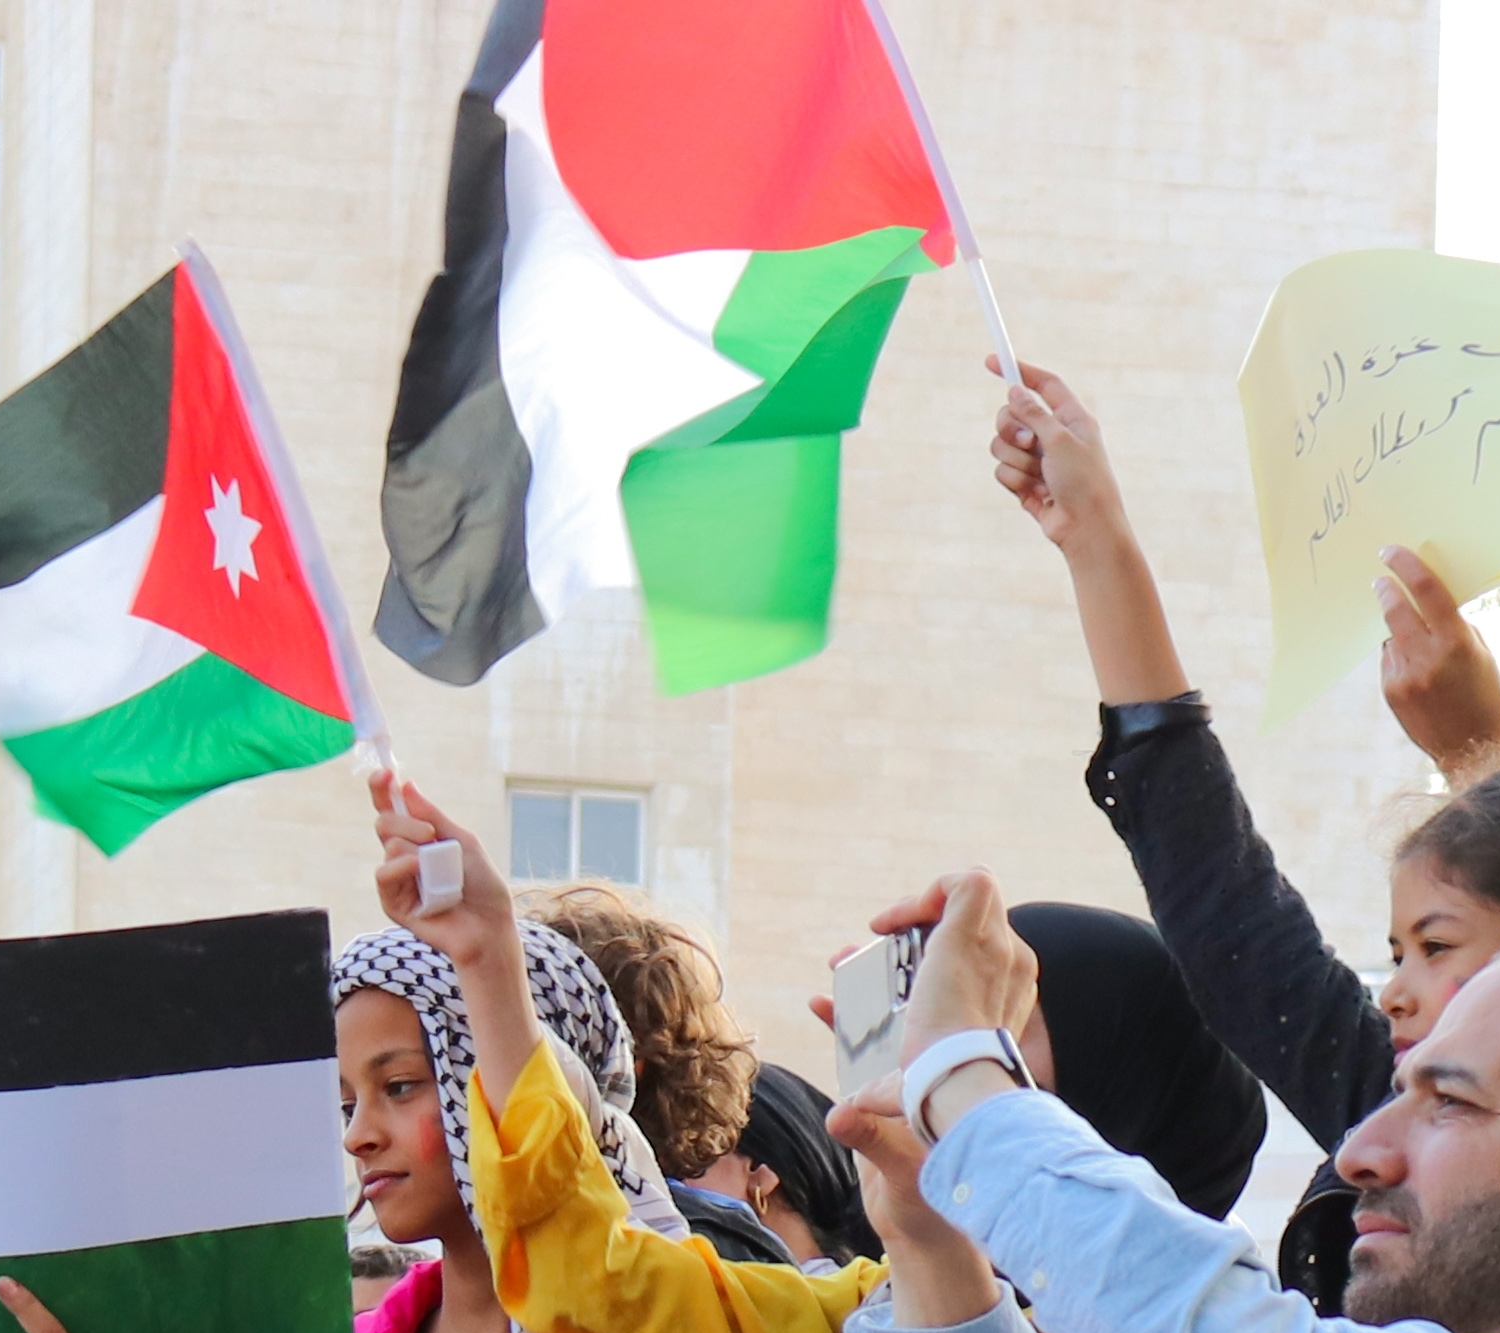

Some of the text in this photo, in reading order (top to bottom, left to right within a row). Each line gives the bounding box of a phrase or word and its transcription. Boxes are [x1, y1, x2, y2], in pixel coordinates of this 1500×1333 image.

[1293, 350, 1348, 459] العزة
[1359, 335, 1442, 379] غزة
[1353, 386, 1474, 485] أبطال
[1309, 466, 1352, 586] العالم
